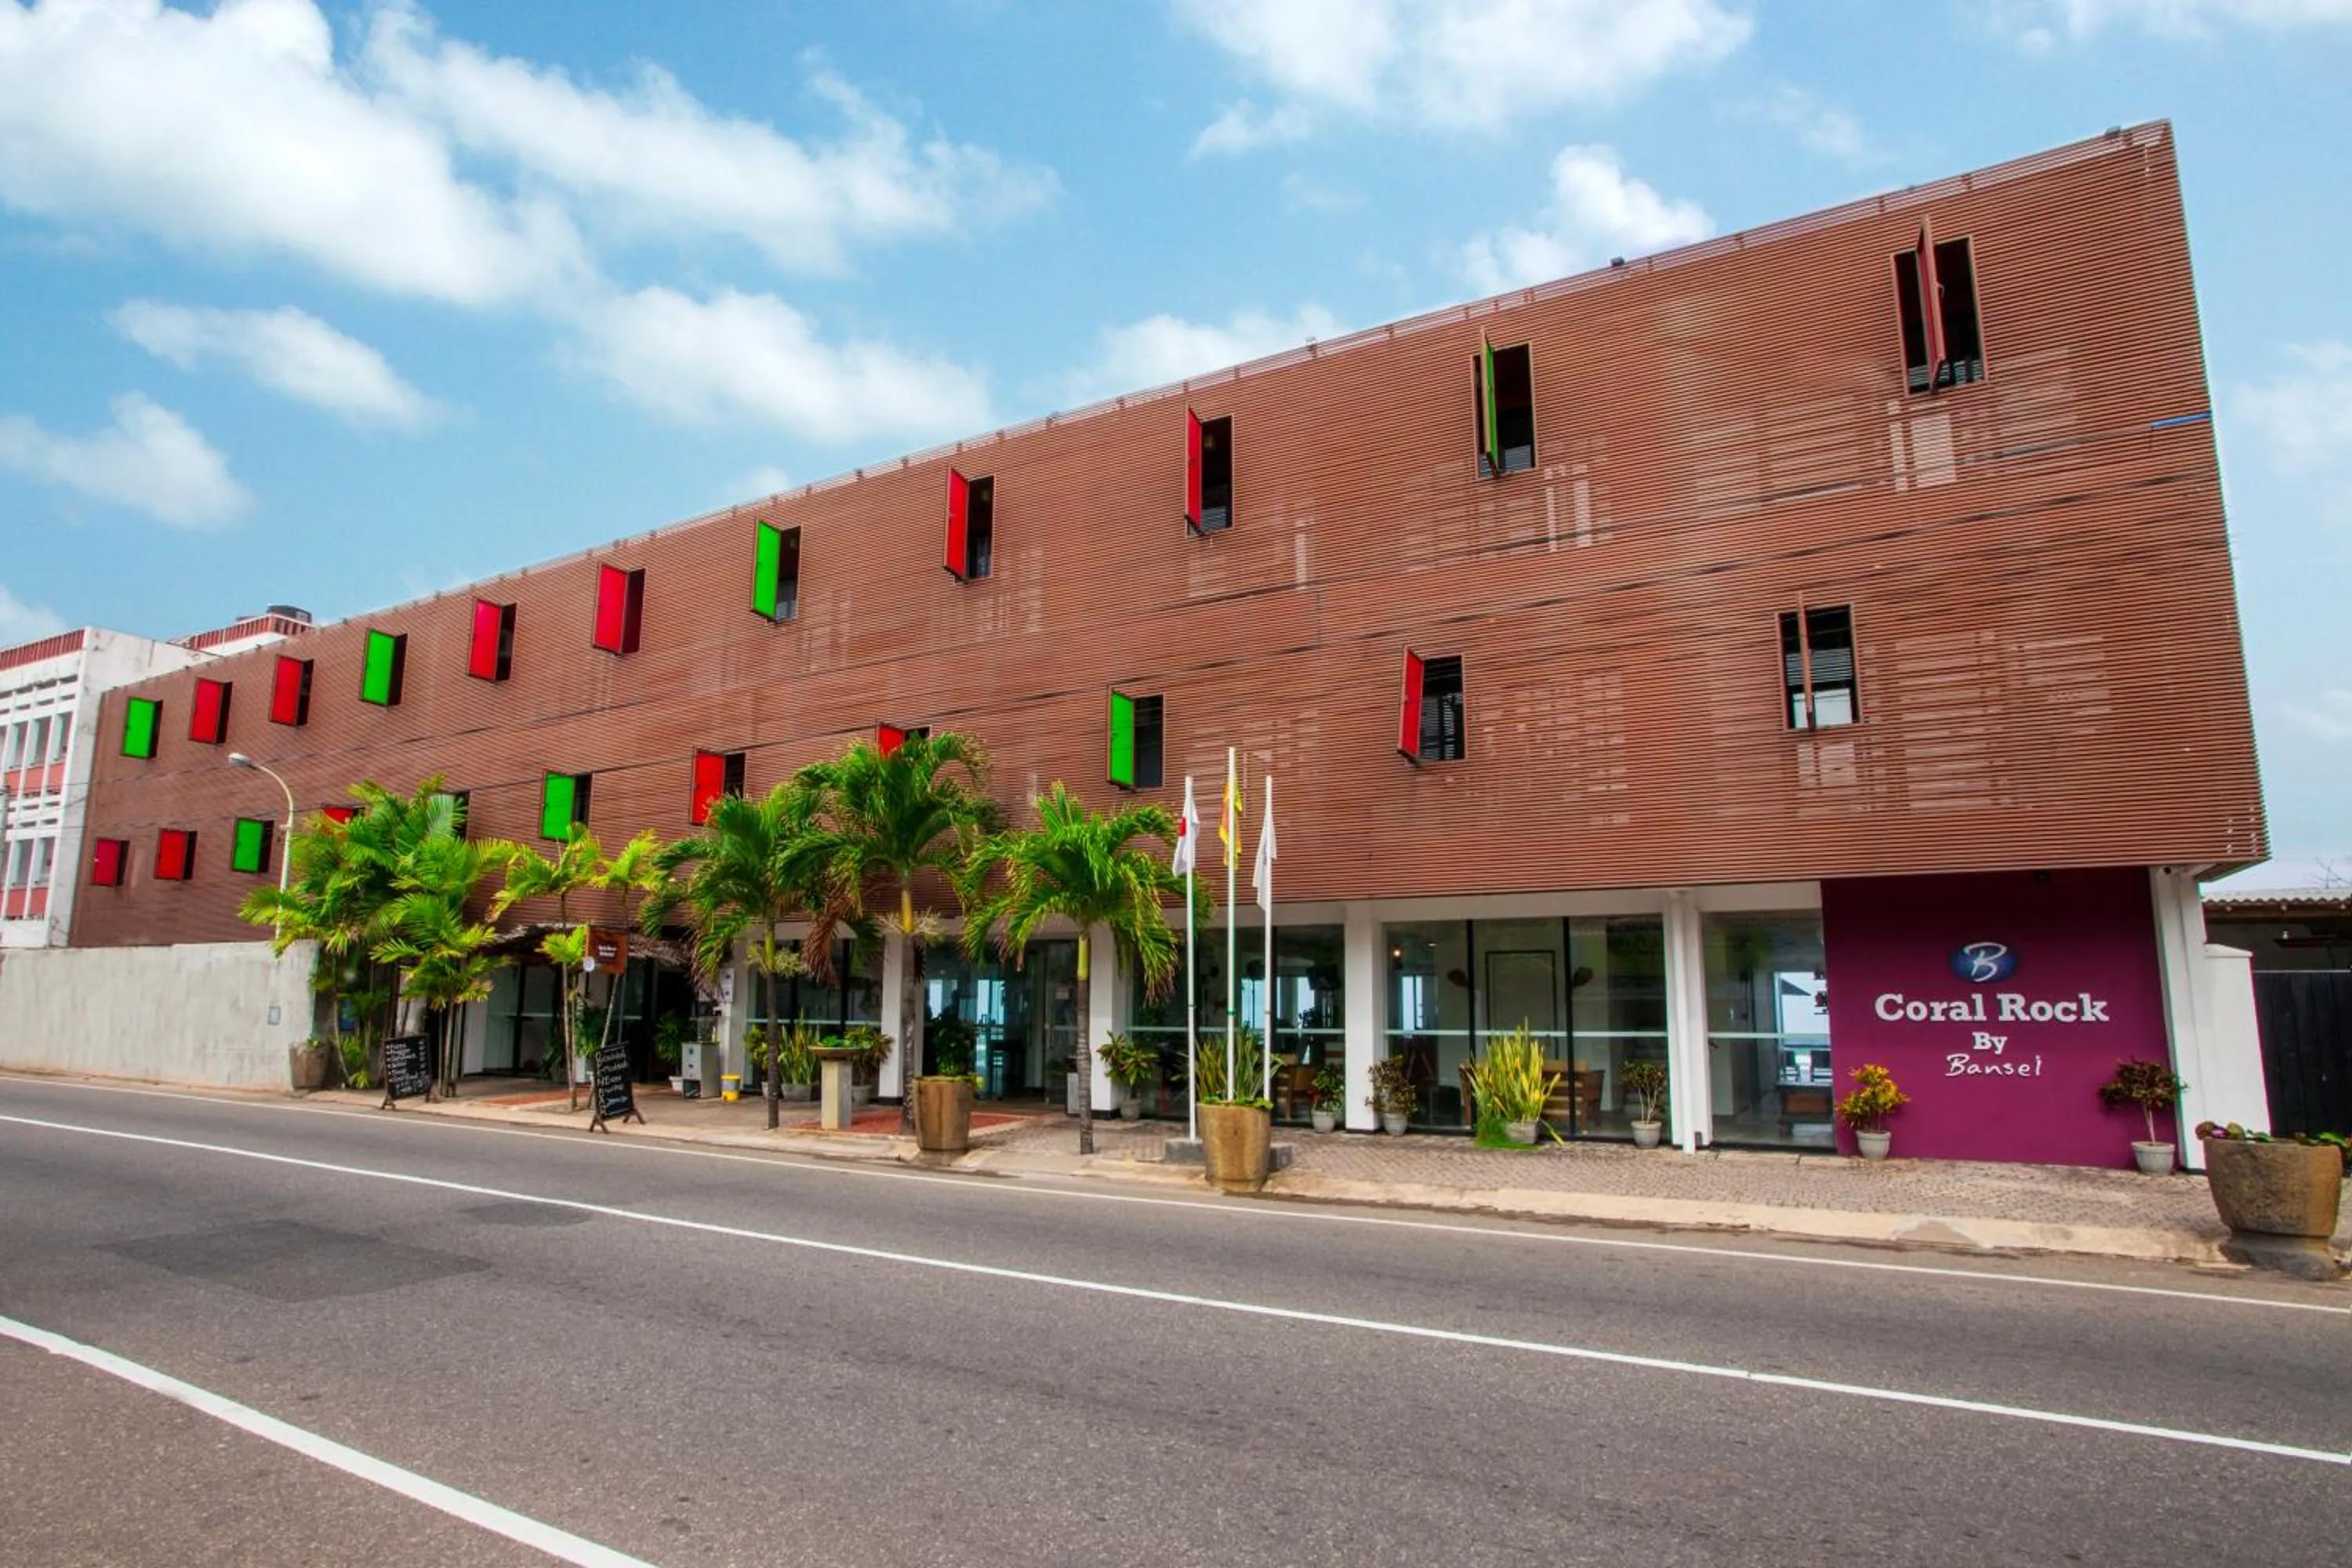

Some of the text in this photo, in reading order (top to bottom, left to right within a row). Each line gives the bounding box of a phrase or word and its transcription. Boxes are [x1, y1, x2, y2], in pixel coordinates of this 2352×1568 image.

[1963, 942, 2007, 982] B
[1875, 993, 2110, 1022] Coral Rock
[1972, 1031, 2008, 1054] By
[1945, 1053, 2042, 1077] Bansel
